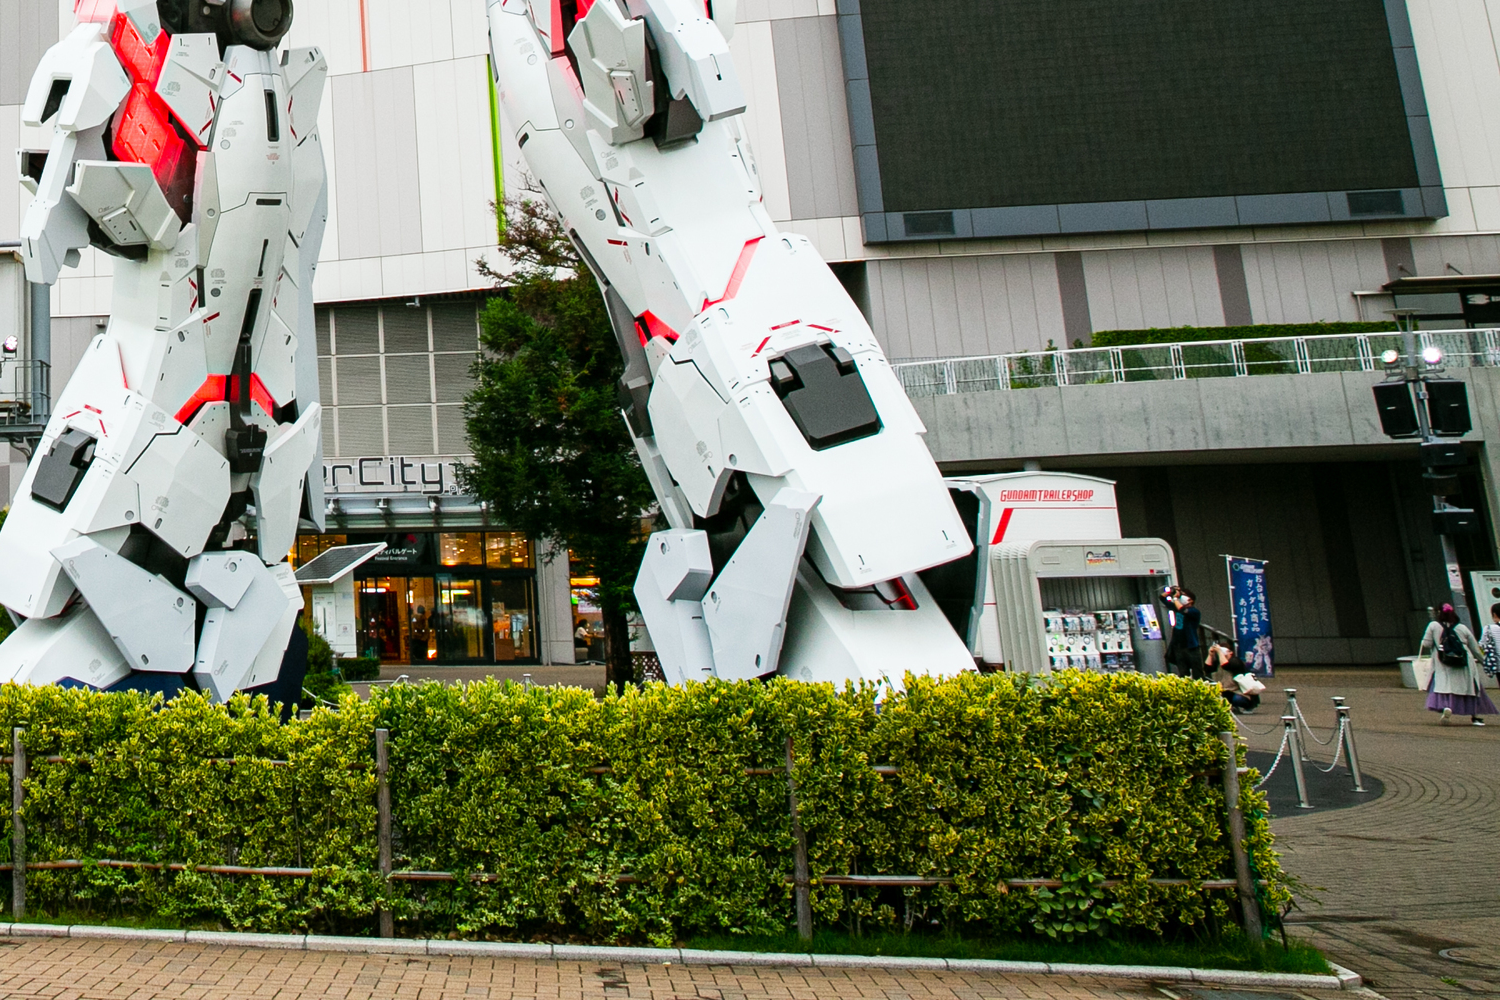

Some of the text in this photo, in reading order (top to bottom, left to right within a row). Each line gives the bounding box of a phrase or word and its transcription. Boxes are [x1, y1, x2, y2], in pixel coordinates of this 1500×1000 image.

[1238, 598, 1249, 635] あります
[1246, 578, 1261, 633] ガンダム商品
[1255, 574, 1269, 622] お台場限定
